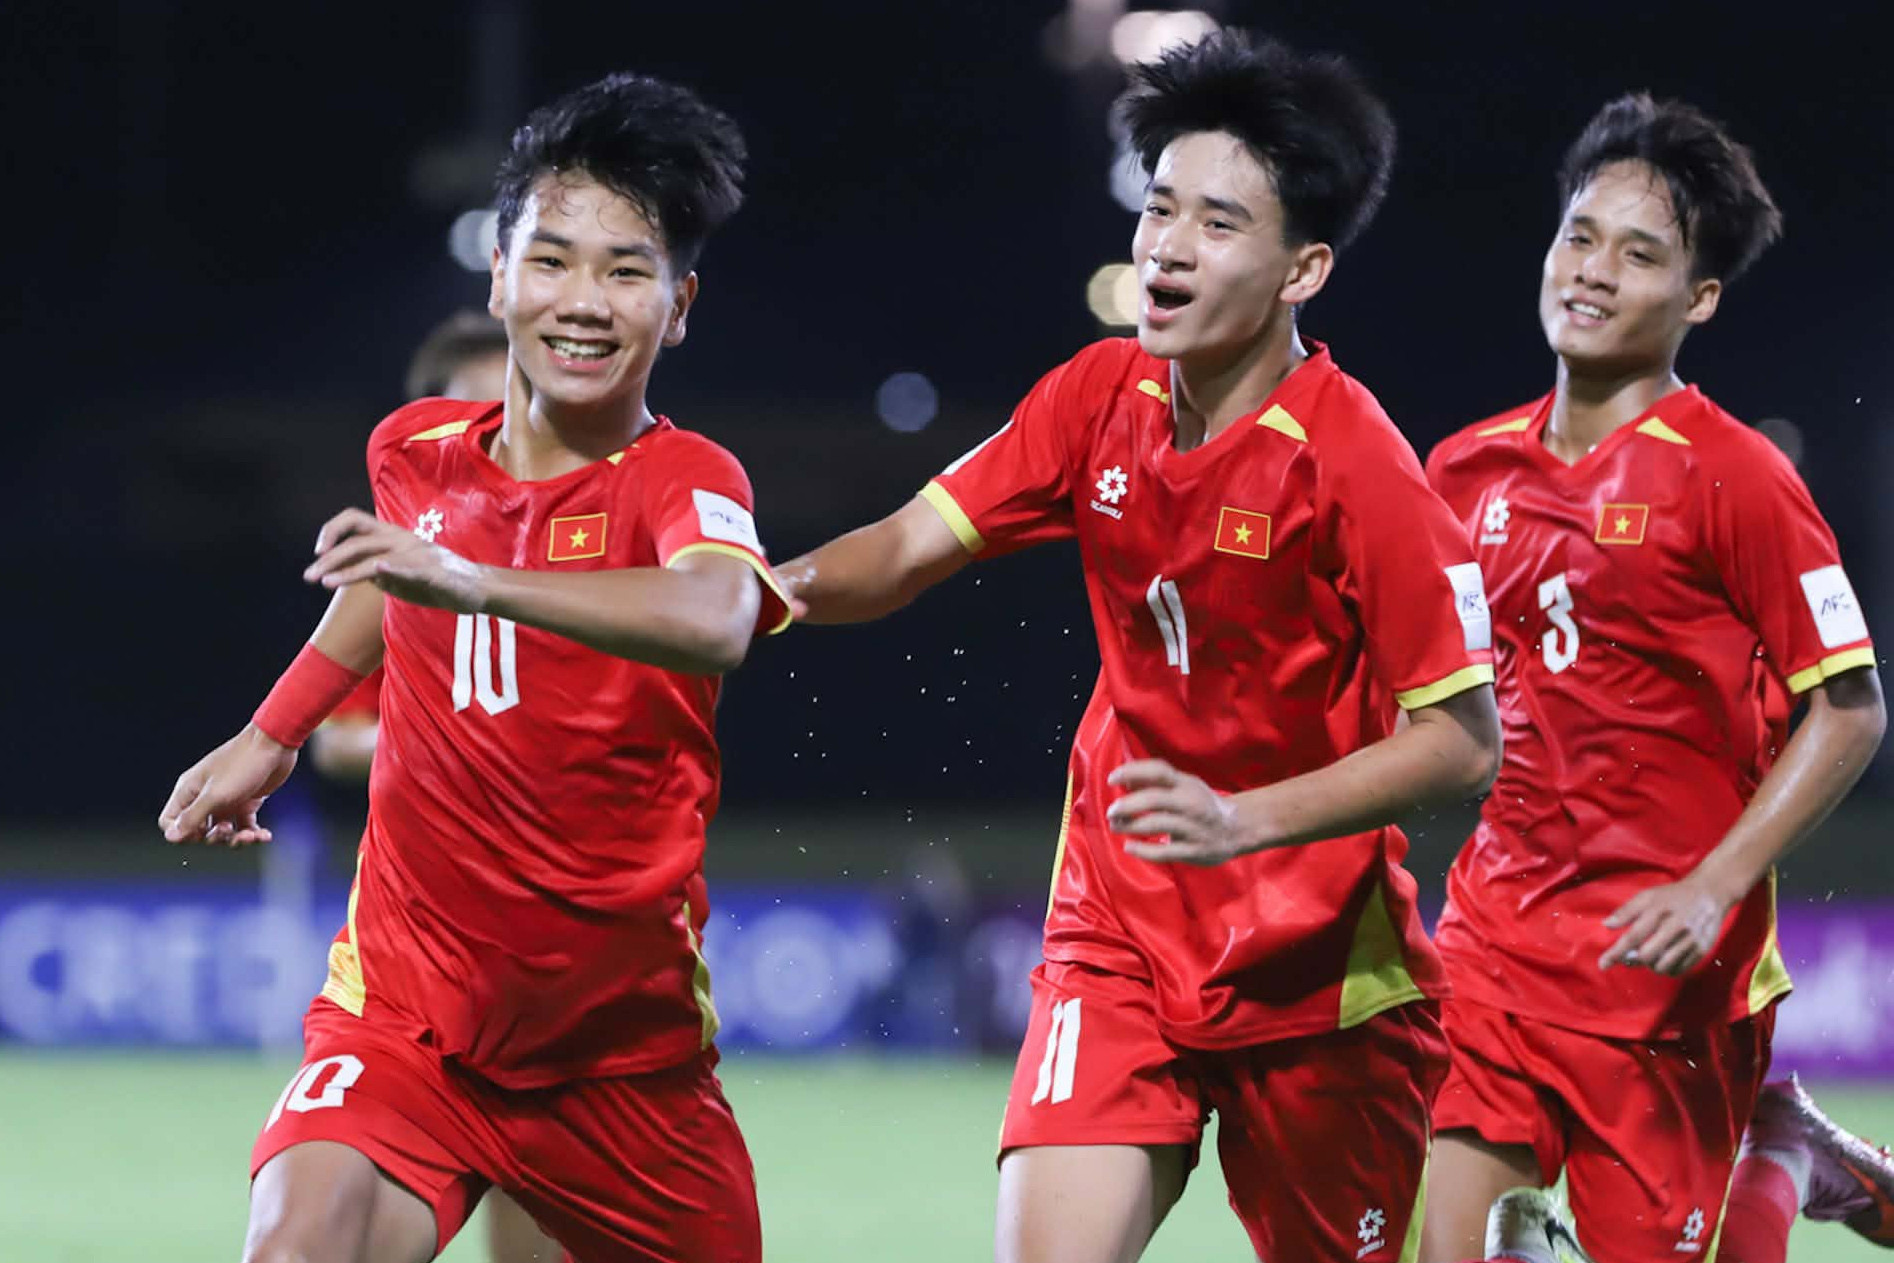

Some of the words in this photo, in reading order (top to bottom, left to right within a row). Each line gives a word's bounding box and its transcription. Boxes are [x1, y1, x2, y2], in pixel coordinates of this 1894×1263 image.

[452, 613, 520, 716] 10
[1146, 573, 1191, 675] 11
[1538, 572, 1580, 675] 3
[264, 1054, 365, 1133] 10
[1031, 998, 1082, 1106] 11
